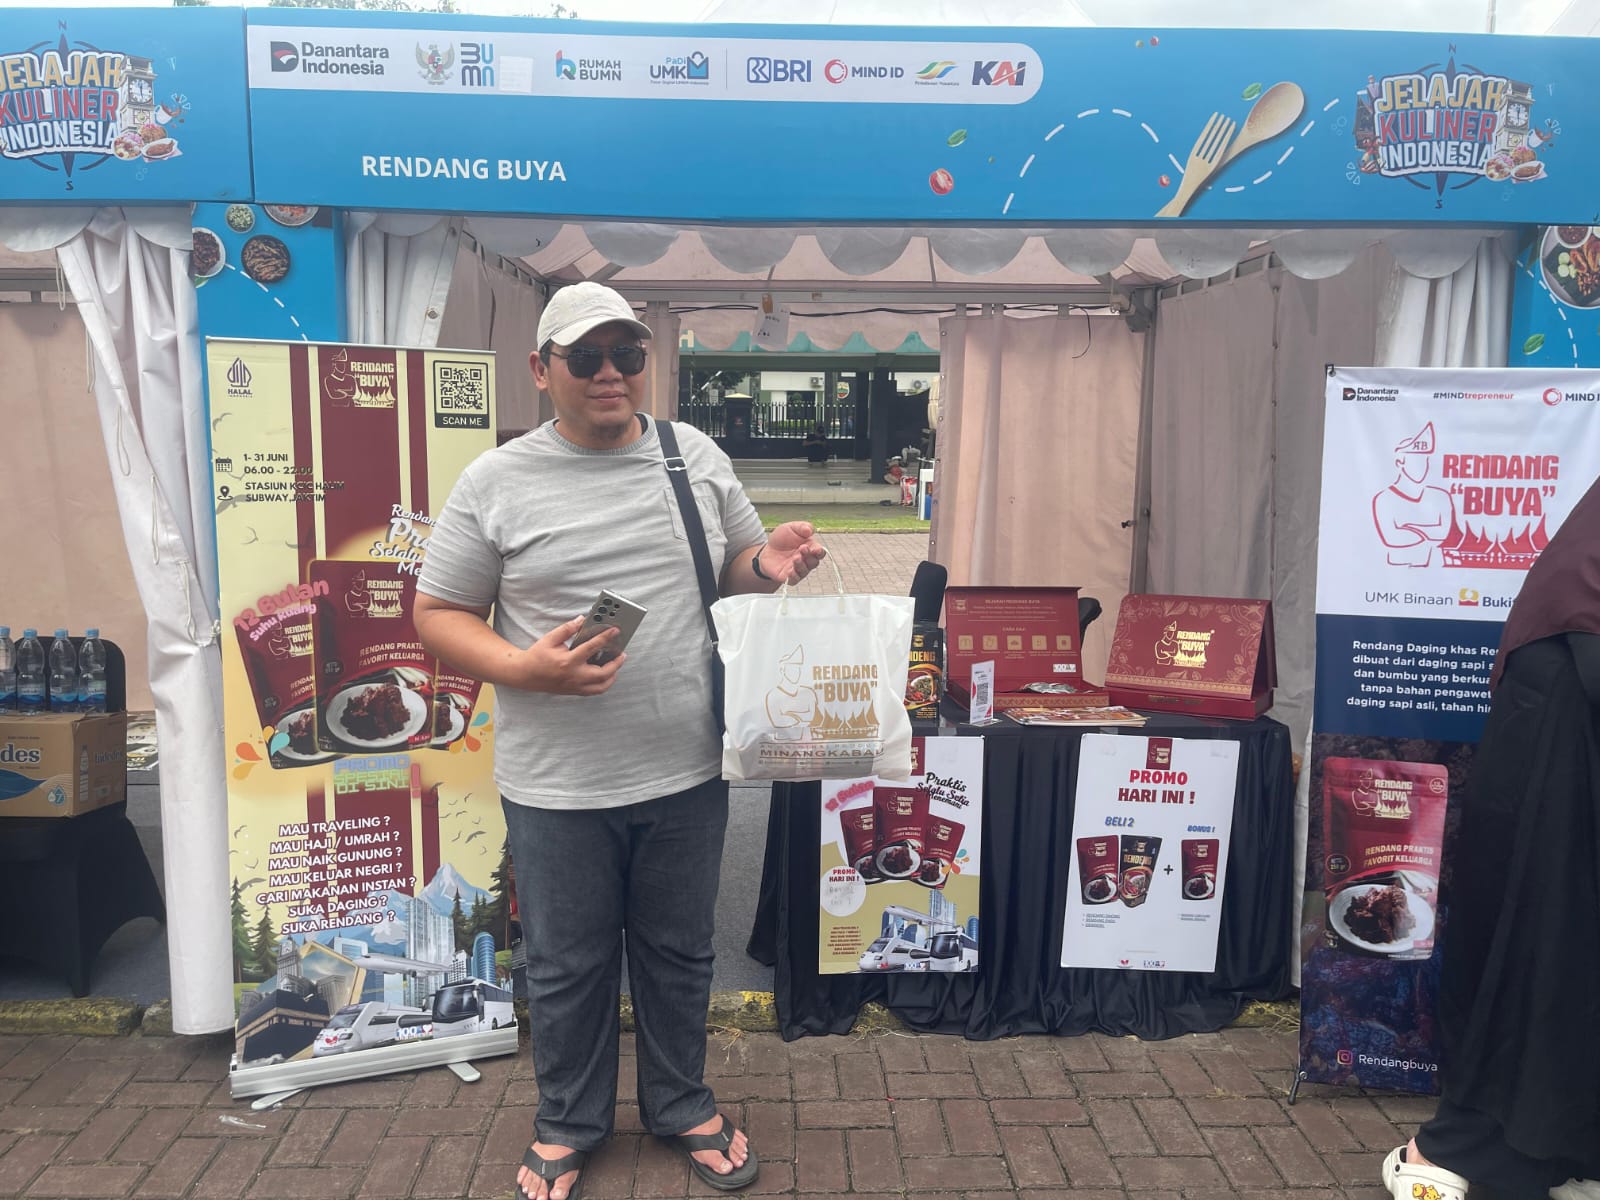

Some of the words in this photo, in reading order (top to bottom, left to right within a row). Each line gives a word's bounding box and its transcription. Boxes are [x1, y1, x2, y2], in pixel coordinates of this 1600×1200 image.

[302, 42, 389, 60] Danantara
[302, 59, 385, 75] Indonesia
[579, 59, 621, 69] RUMAH
[666, 57, 686, 65] PaDi
[579, 69, 621, 81] BUMN
[773, 59, 812, 83] BRI
[851, 66, 887, 78] MIND
[890, 66, 904, 79] ID
[971, 61, 1026, 87] KAI
[1378, 77, 1503, 112] JELAJAH
[0, 88, 119, 126] KULINER
[1379, 108, 1498, 145] KULINER
[1, 120, 116, 152] INDONESIA
[1382, 140, 1492, 170] INDONESIA
[362, 155, 489, 180] RENDANG
[498, 161, 567, 182] BUYA
[350, 361, 395, 374] RENDANG
[354, 374, 394, 388] "BUYA"
[1357, 387, 1399, 396] Danantara
[1357, 394, 1396, 402] Indonesia
[1433, 392, 1514, 401] #MINDtrepreneur
[1565, 392, 1596, 402] MIND
[442, 416, 467, 426] SCAN
[469, 417, 483, 426] ME
[254, 453, 264, 461] 31
[266, 453, 288, 461] JUNI
[244, 466, 274, 474] 06.00
[1442, 454, 1559, 480] RENDANG
[245, 482, 287, 490] STASIUN
[1450, 485, 1556, 517] "BUYA"
[391, 503, 437, 527] Rendan
[366, 579, 404, 589] RENDANG
[232, 607, 260, 632] 12
[257, 580, 330, 616] Bulan
[1365, 591, 1399, 604] UMK
[1404, 592, 1453, 606] Binaan
[284, 624, 313, 635] RENDAN
[1176, 630, 1212, 641] RENDANG
[359, 642, 395, 656] RENDANG
[1352, 641, 1404, 653] Rendang
[1406, 642, 1447, 655] Daging
[1450, 644, 1477, 655] khas
[358, 653, 389, 667] FAVORIT
[389, 652, 425, 660] KELUARGA
[1352, 654, 1389, 666] dibuat
[1392, 656, 1416, 667] dari
[1418, 658, 1458, 670] daging
[1461, 660, 1486, 671] sapi
[812, 664, 878, 681] RENDANG
[1353, 669, 1375, 679] dan
[1377, 670, 1418, 682] bumbu
[1420, 674, 1449, 684] yang
[814, 681, 878, 703] "BUYA"
[1360, 683, 1393, 695] tanpa
[1396, 685, 1431, 696] bahan
[1346, 696, 1386, 709] daging
[1388, 698, 1413, 710] sapi
[1415, 700, 1439, 712] asli,
[1441, 702, 1474, 713] tahan
[334, 754, 411, 774] PROMO
[926, 772, 967, 793] Praktis
[1129, 769, 1188, 786] PROMO
[1374, 779, 1413, 790] RENDANG
[336, 782, 360, 795] DI
[365, 778, 410, 792] SINI
[1118, 787, 1157, 803] HARI
[1161, 790, 1184, 804] INI
[1189, 791, 1196, 805] !
[279, 824, 310, 837] MAU
[312, 817, 382, 833] TRAVELING
[383, 815, 391, 827] ?
[1105, 816, 1127, 827] BELI
[1127, 817, 1135, 827] 2
[270, 840, 301, 854] MAU
[303, 838, 332, 851] HAJI
[344, 831, 390, 847] UMRAH
[393, 830, 400, 842] ?
[1364, 845, 1402, 856] RENDANG
[1402, 844, 1434, 855] PRAKTIS
[268, 857, 300, 871] MAU
[302, 853, 336, 868] NAIK
[336, 847, 393, 865] GUNUNG
[395, 846, 403, 858] ?
[1363, 855, 1394, 868] FAVORIT
[1394, 854, 1433, 866] KELUARGA
[269, 873, 300, 888] MAU
[302, 868, 353, 885] KELUAR
[355, 863, 393, 877] NEGRI
[395, 862, 403, 873] ?
[257, 890, 289, 905] CARI
[291, 884, 360, 902] MAKANAN
[361, 878, 407, 896] INSTAN
[409, 876, 417, 888] ?
[288, 903, 326, 918] SUKA
[327, 898, 378, 914] DAGING
[380, 895, 388, 907] ?
[282, 920, 320, 935] SUKA
[320, 912, 383, 930] RENDANG
[387, 910, 396, 922] ?
[1359, 1054, 1438, 1072] Rendangbuya
